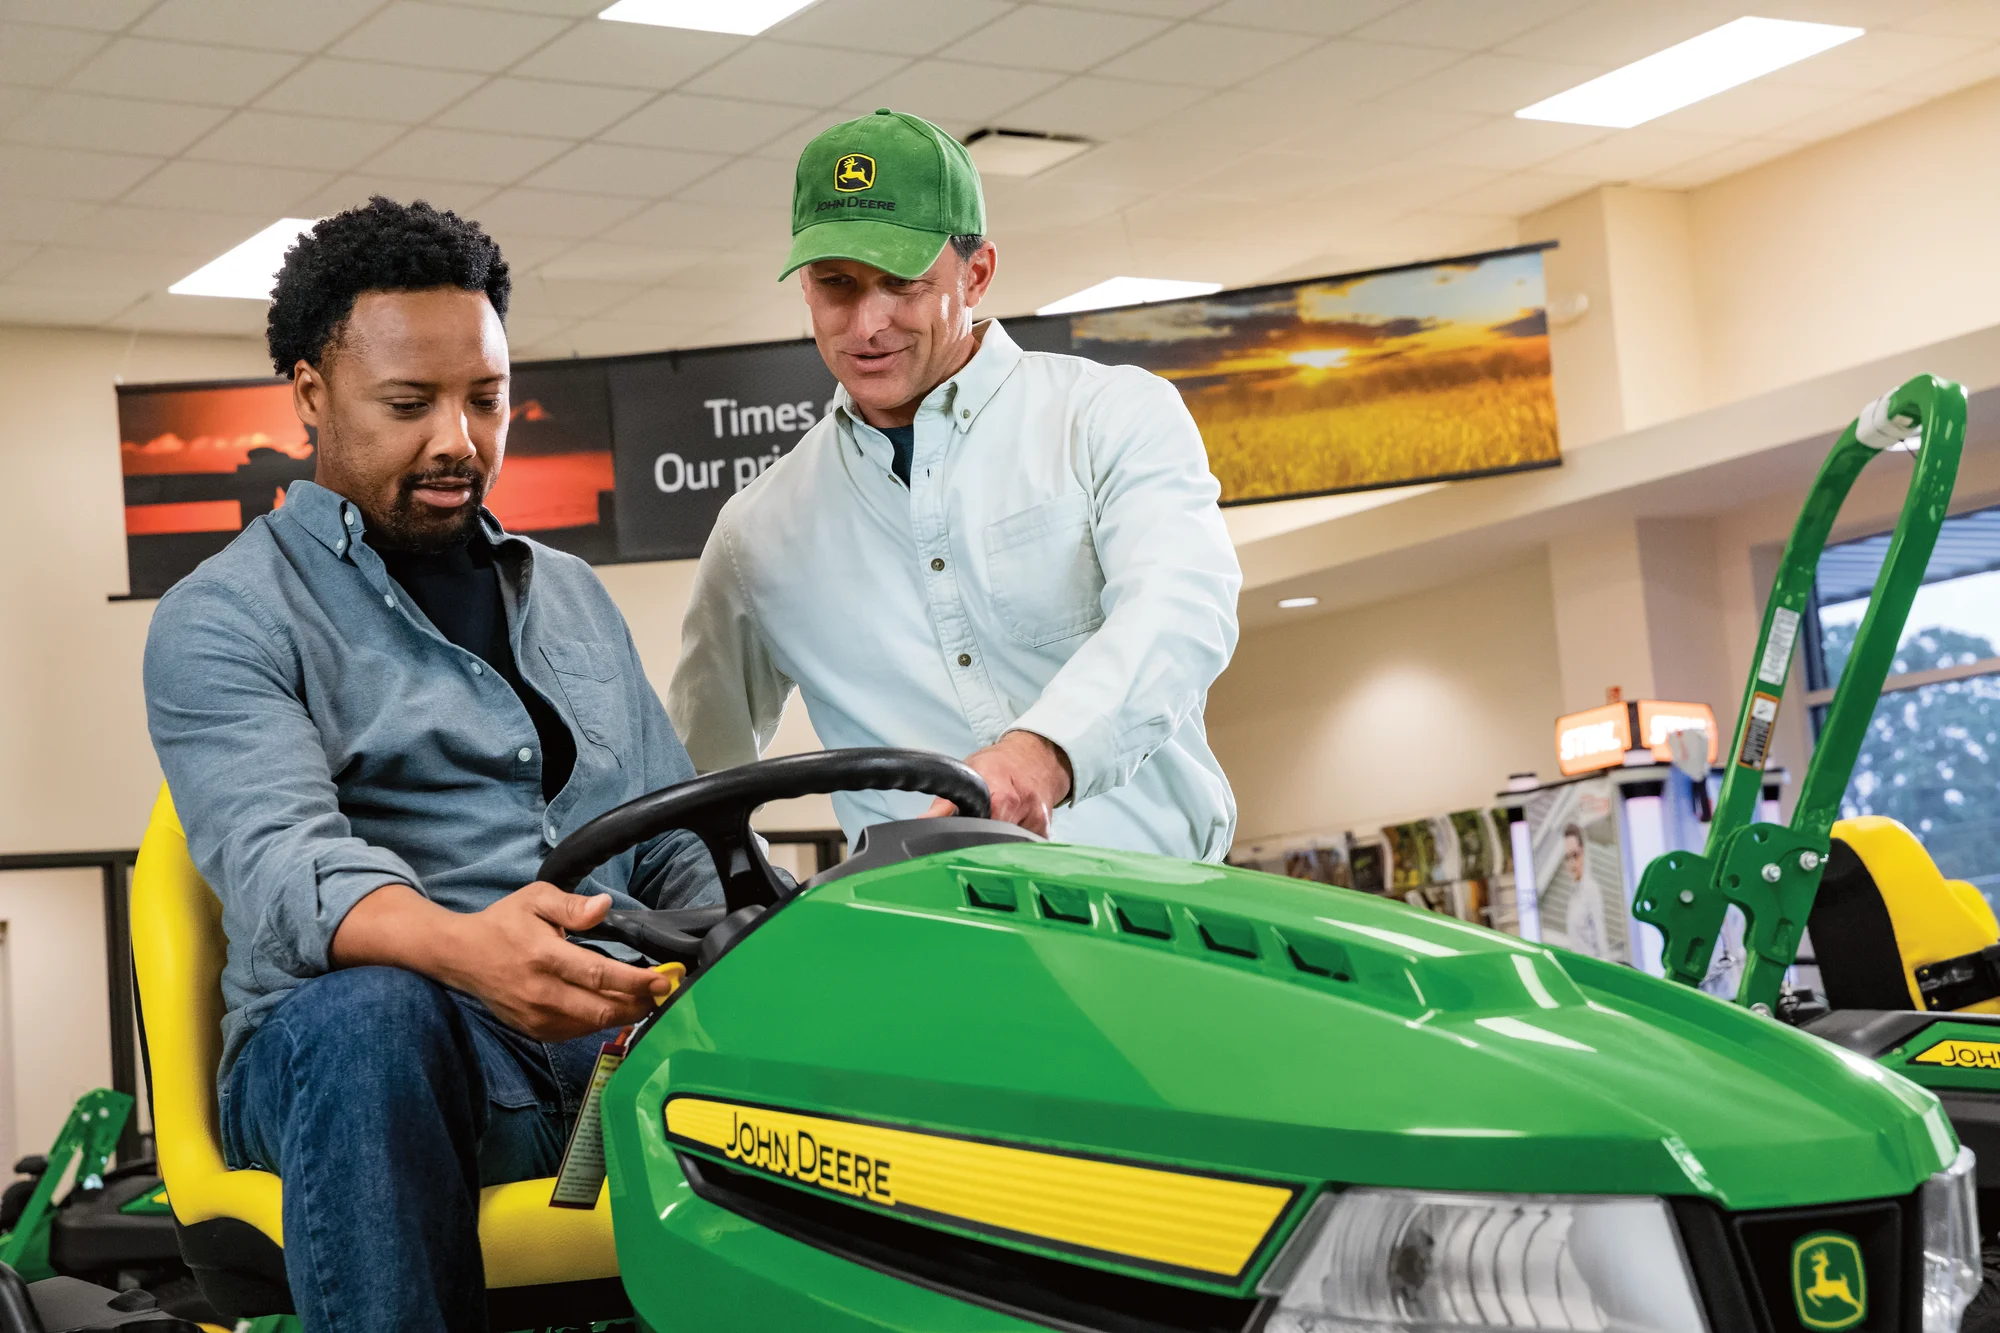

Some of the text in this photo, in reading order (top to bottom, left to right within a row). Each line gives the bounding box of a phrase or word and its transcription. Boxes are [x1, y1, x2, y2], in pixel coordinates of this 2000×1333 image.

[814, 196, 896, 213] JOHN DEERE
[704, 398, 816, 438] Times
[654, 452, 726, 493] Our
[1944, 1044, 2000, 1065] JOH
[726, 1111, 891, 1197] JOHN DEERE
